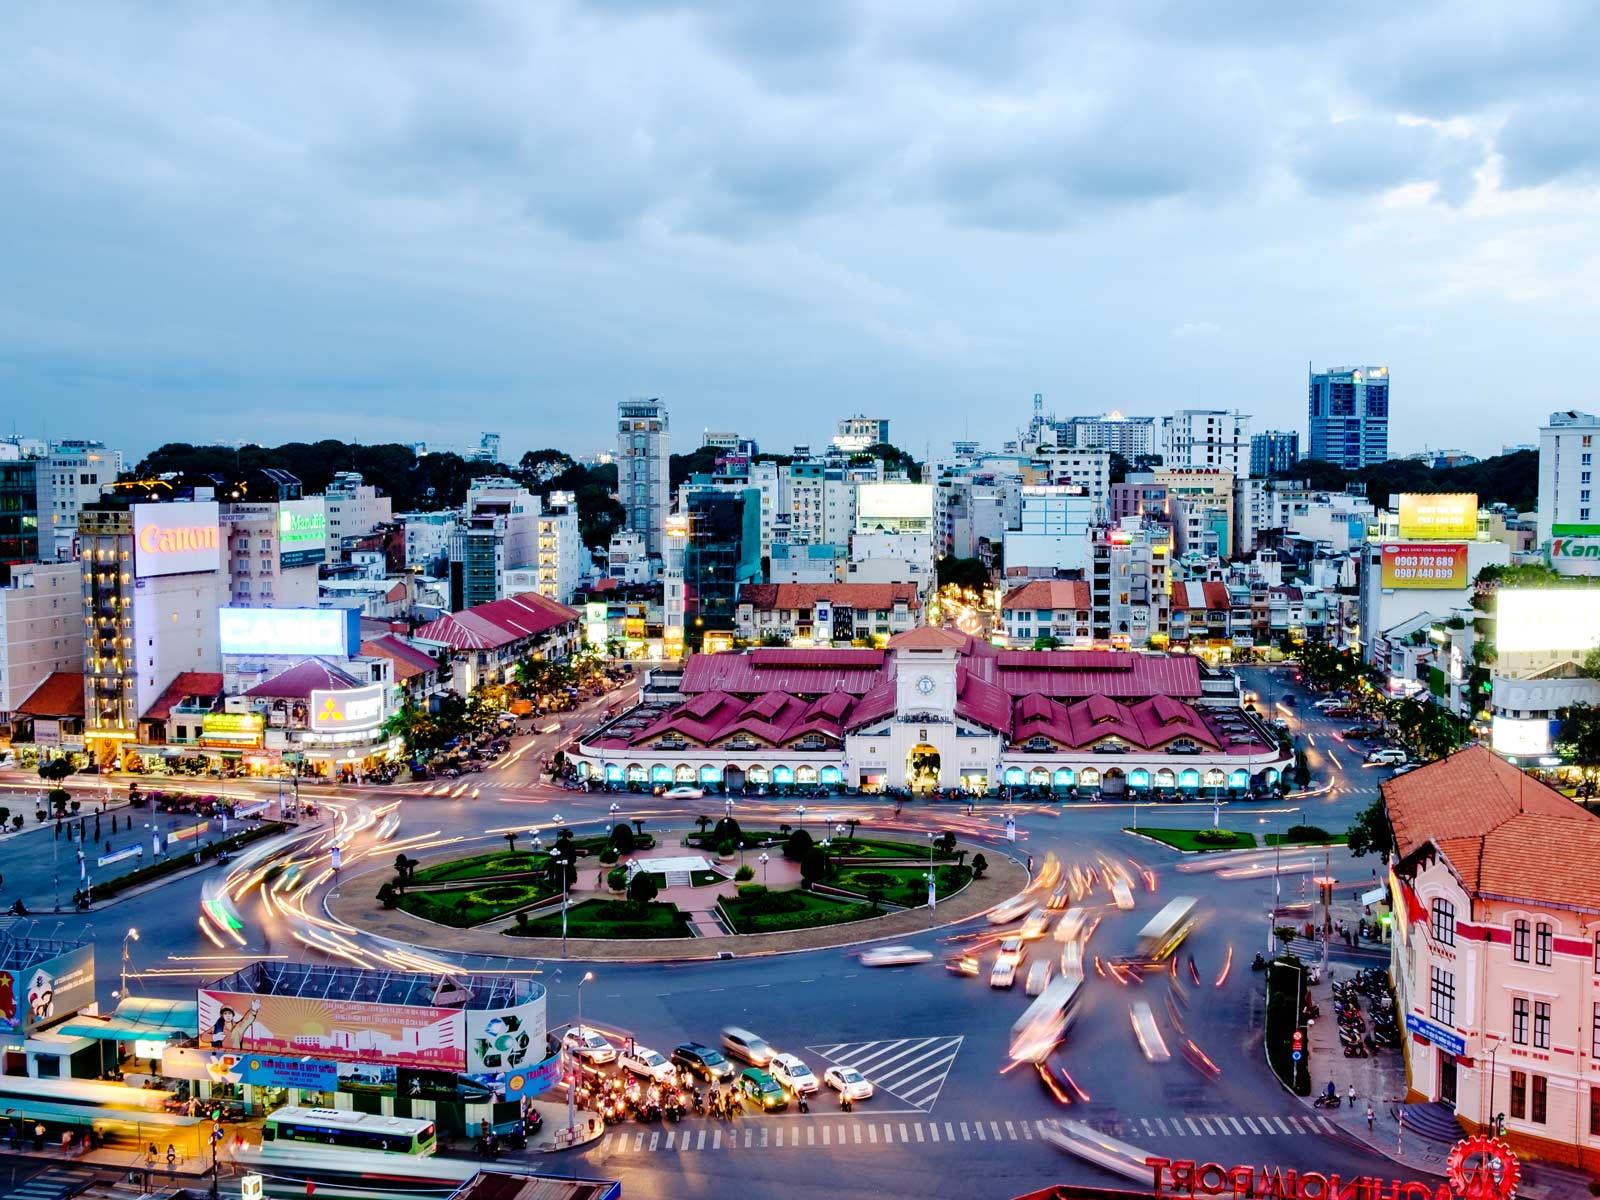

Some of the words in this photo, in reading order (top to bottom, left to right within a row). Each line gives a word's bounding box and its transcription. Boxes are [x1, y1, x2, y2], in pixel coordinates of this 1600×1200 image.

[140, 525, 217, 553] Canon
[1395, 556, 1417, 566] 0903
[1419, 556, 1434, 566] 702
[1436, 556, 1453, 566] 689
[1395, 568, 1416, 578] 0987
[1418, 568, 1433, 578] 440
